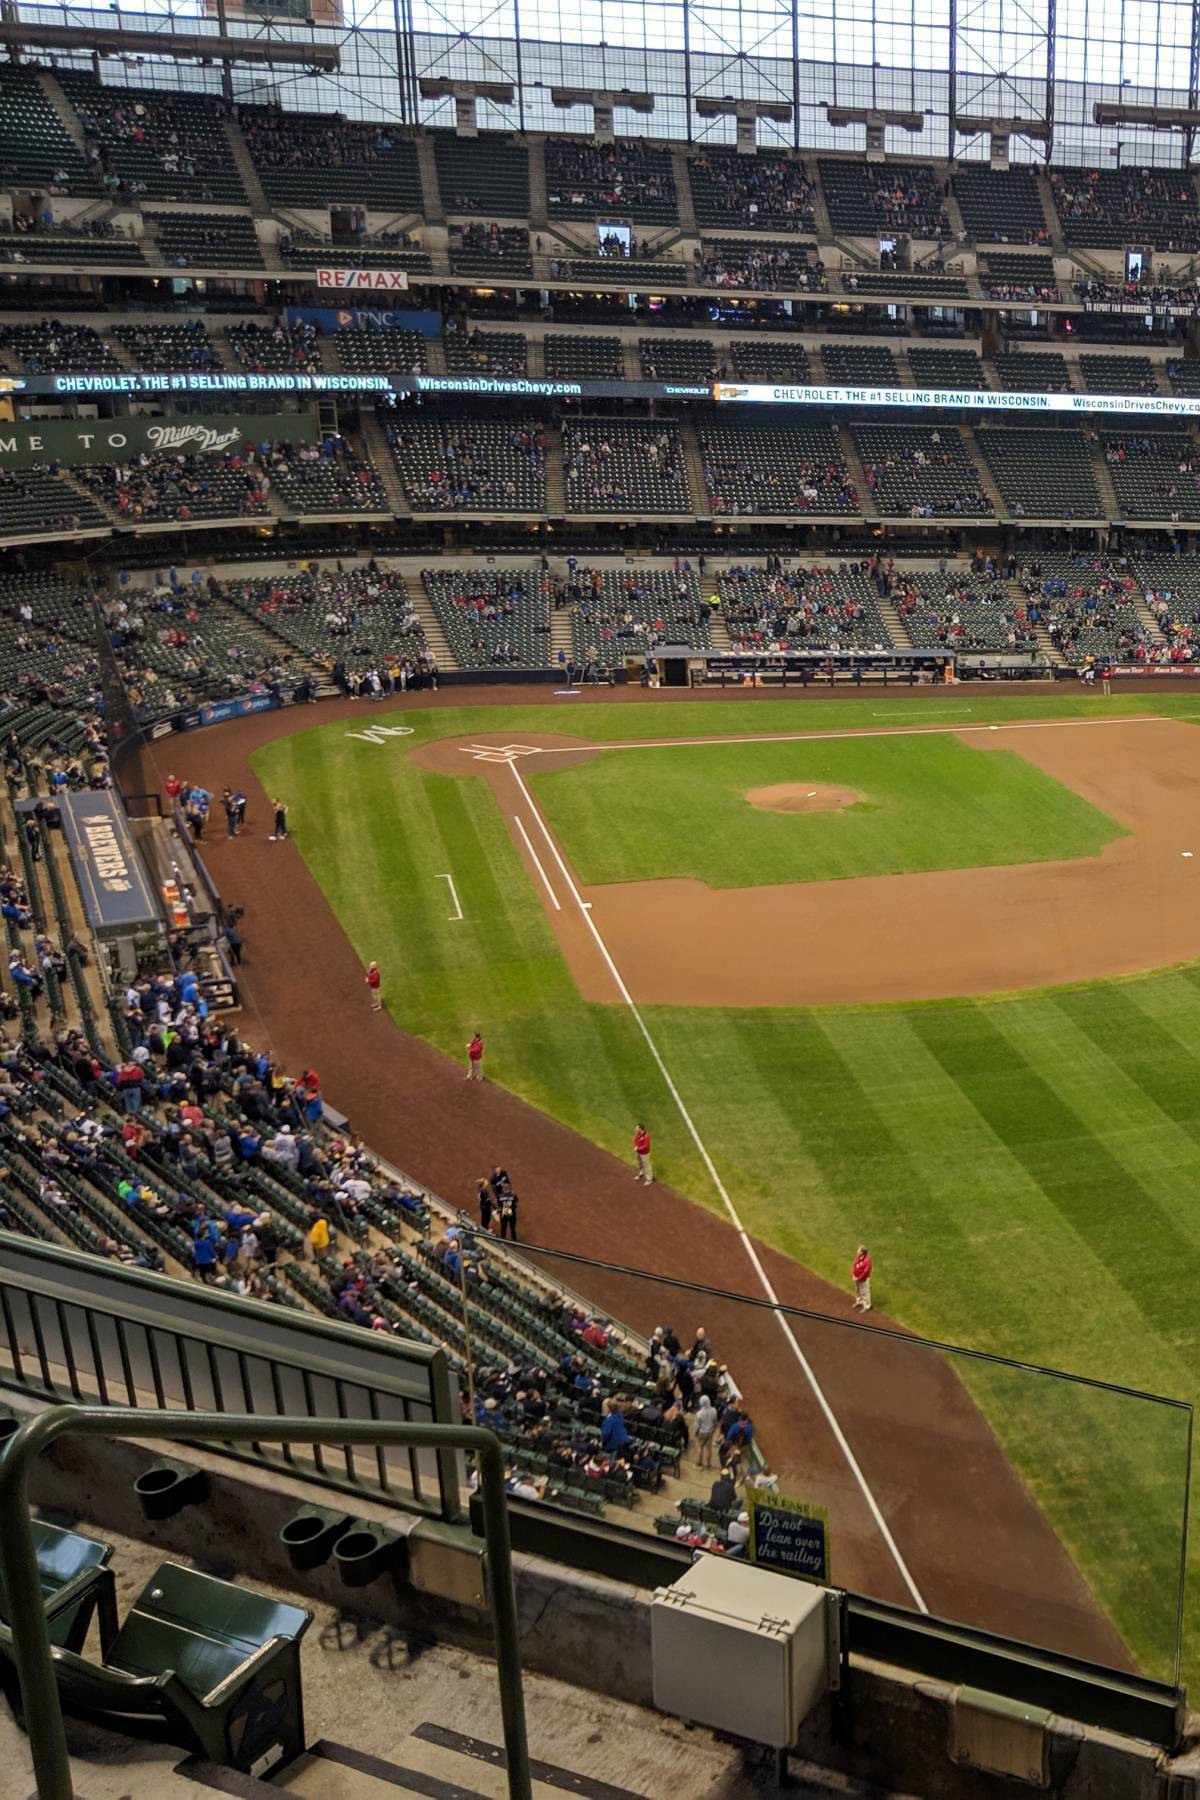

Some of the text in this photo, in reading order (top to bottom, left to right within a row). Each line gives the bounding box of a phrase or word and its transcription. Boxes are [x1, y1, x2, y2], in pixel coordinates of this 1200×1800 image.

[319, 271, 404, 288] RE/MAX
[356, 312, 394, 327] PNC
[57, 376, 392, 391] CHEVROLET. THE #1 SELLING BRAND IN WISCONSIN.
[418, 377, 581, 395] WisconsinDrivesChevy.com
[773, 388, 1050, 407] CHEVROLET. THE #1 SELLING BRAND IN WISCONSIN.
[78, 433, 127, 449] TO
[147, 425, 206, 450] Miller
[200, 427, 243, 451] Park
[84, 825, 129, 878] BREWERS
[759, 1511, 803, 1531] Do not
[766, 1527, 821, 1550] lean over
[758, 1543, 822, 1570] the railing
